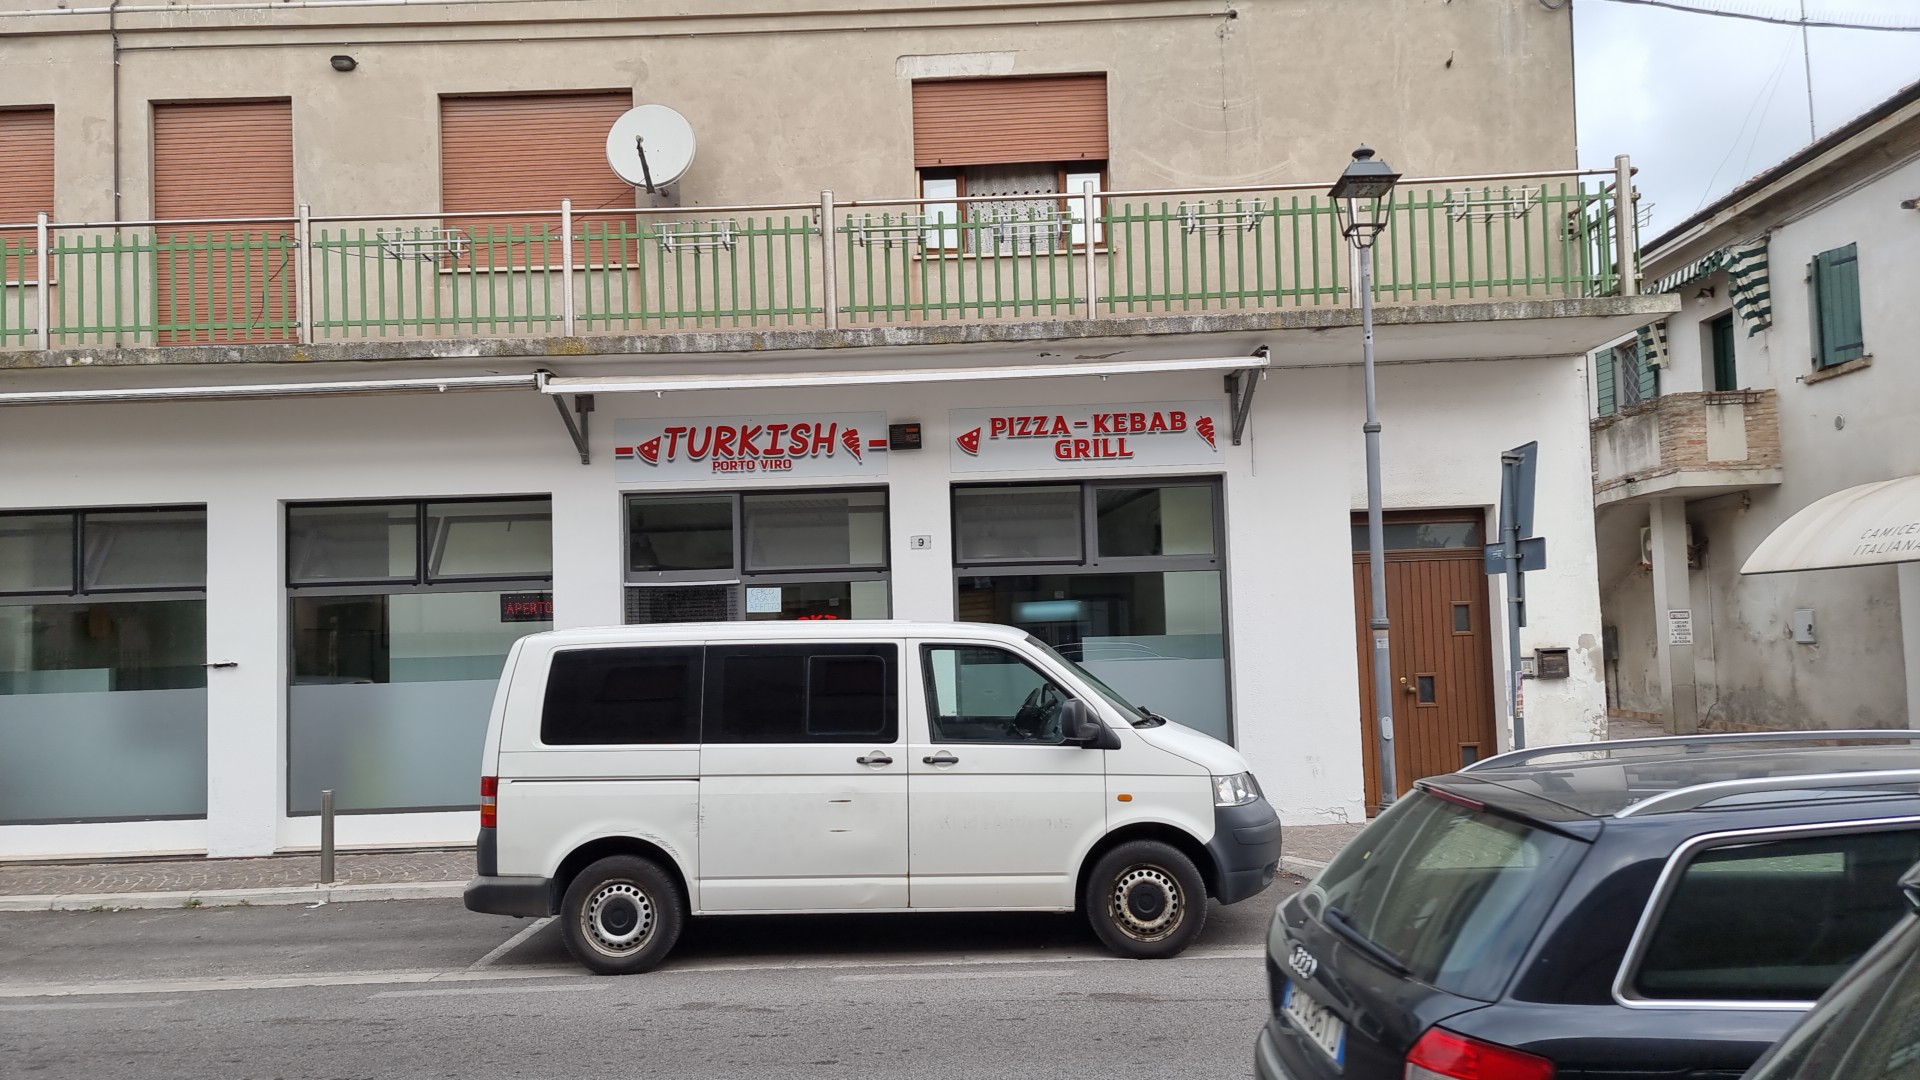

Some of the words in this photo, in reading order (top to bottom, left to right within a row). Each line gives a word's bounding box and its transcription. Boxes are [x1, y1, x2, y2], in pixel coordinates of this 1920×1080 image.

[990, 415, 1070, 437] PIZZA
[1092, 411, 1187, 433] KEBAB
[664, 422, 837, 459] TURKISH
[1054, 437, 1133, 459] GRILL
[712, 459, 755, 471] PORTO
[761, 459, 792, 470] VIRO
[917, 537, 925, 547] 9
[506, 601, 553, 615] APERTO
